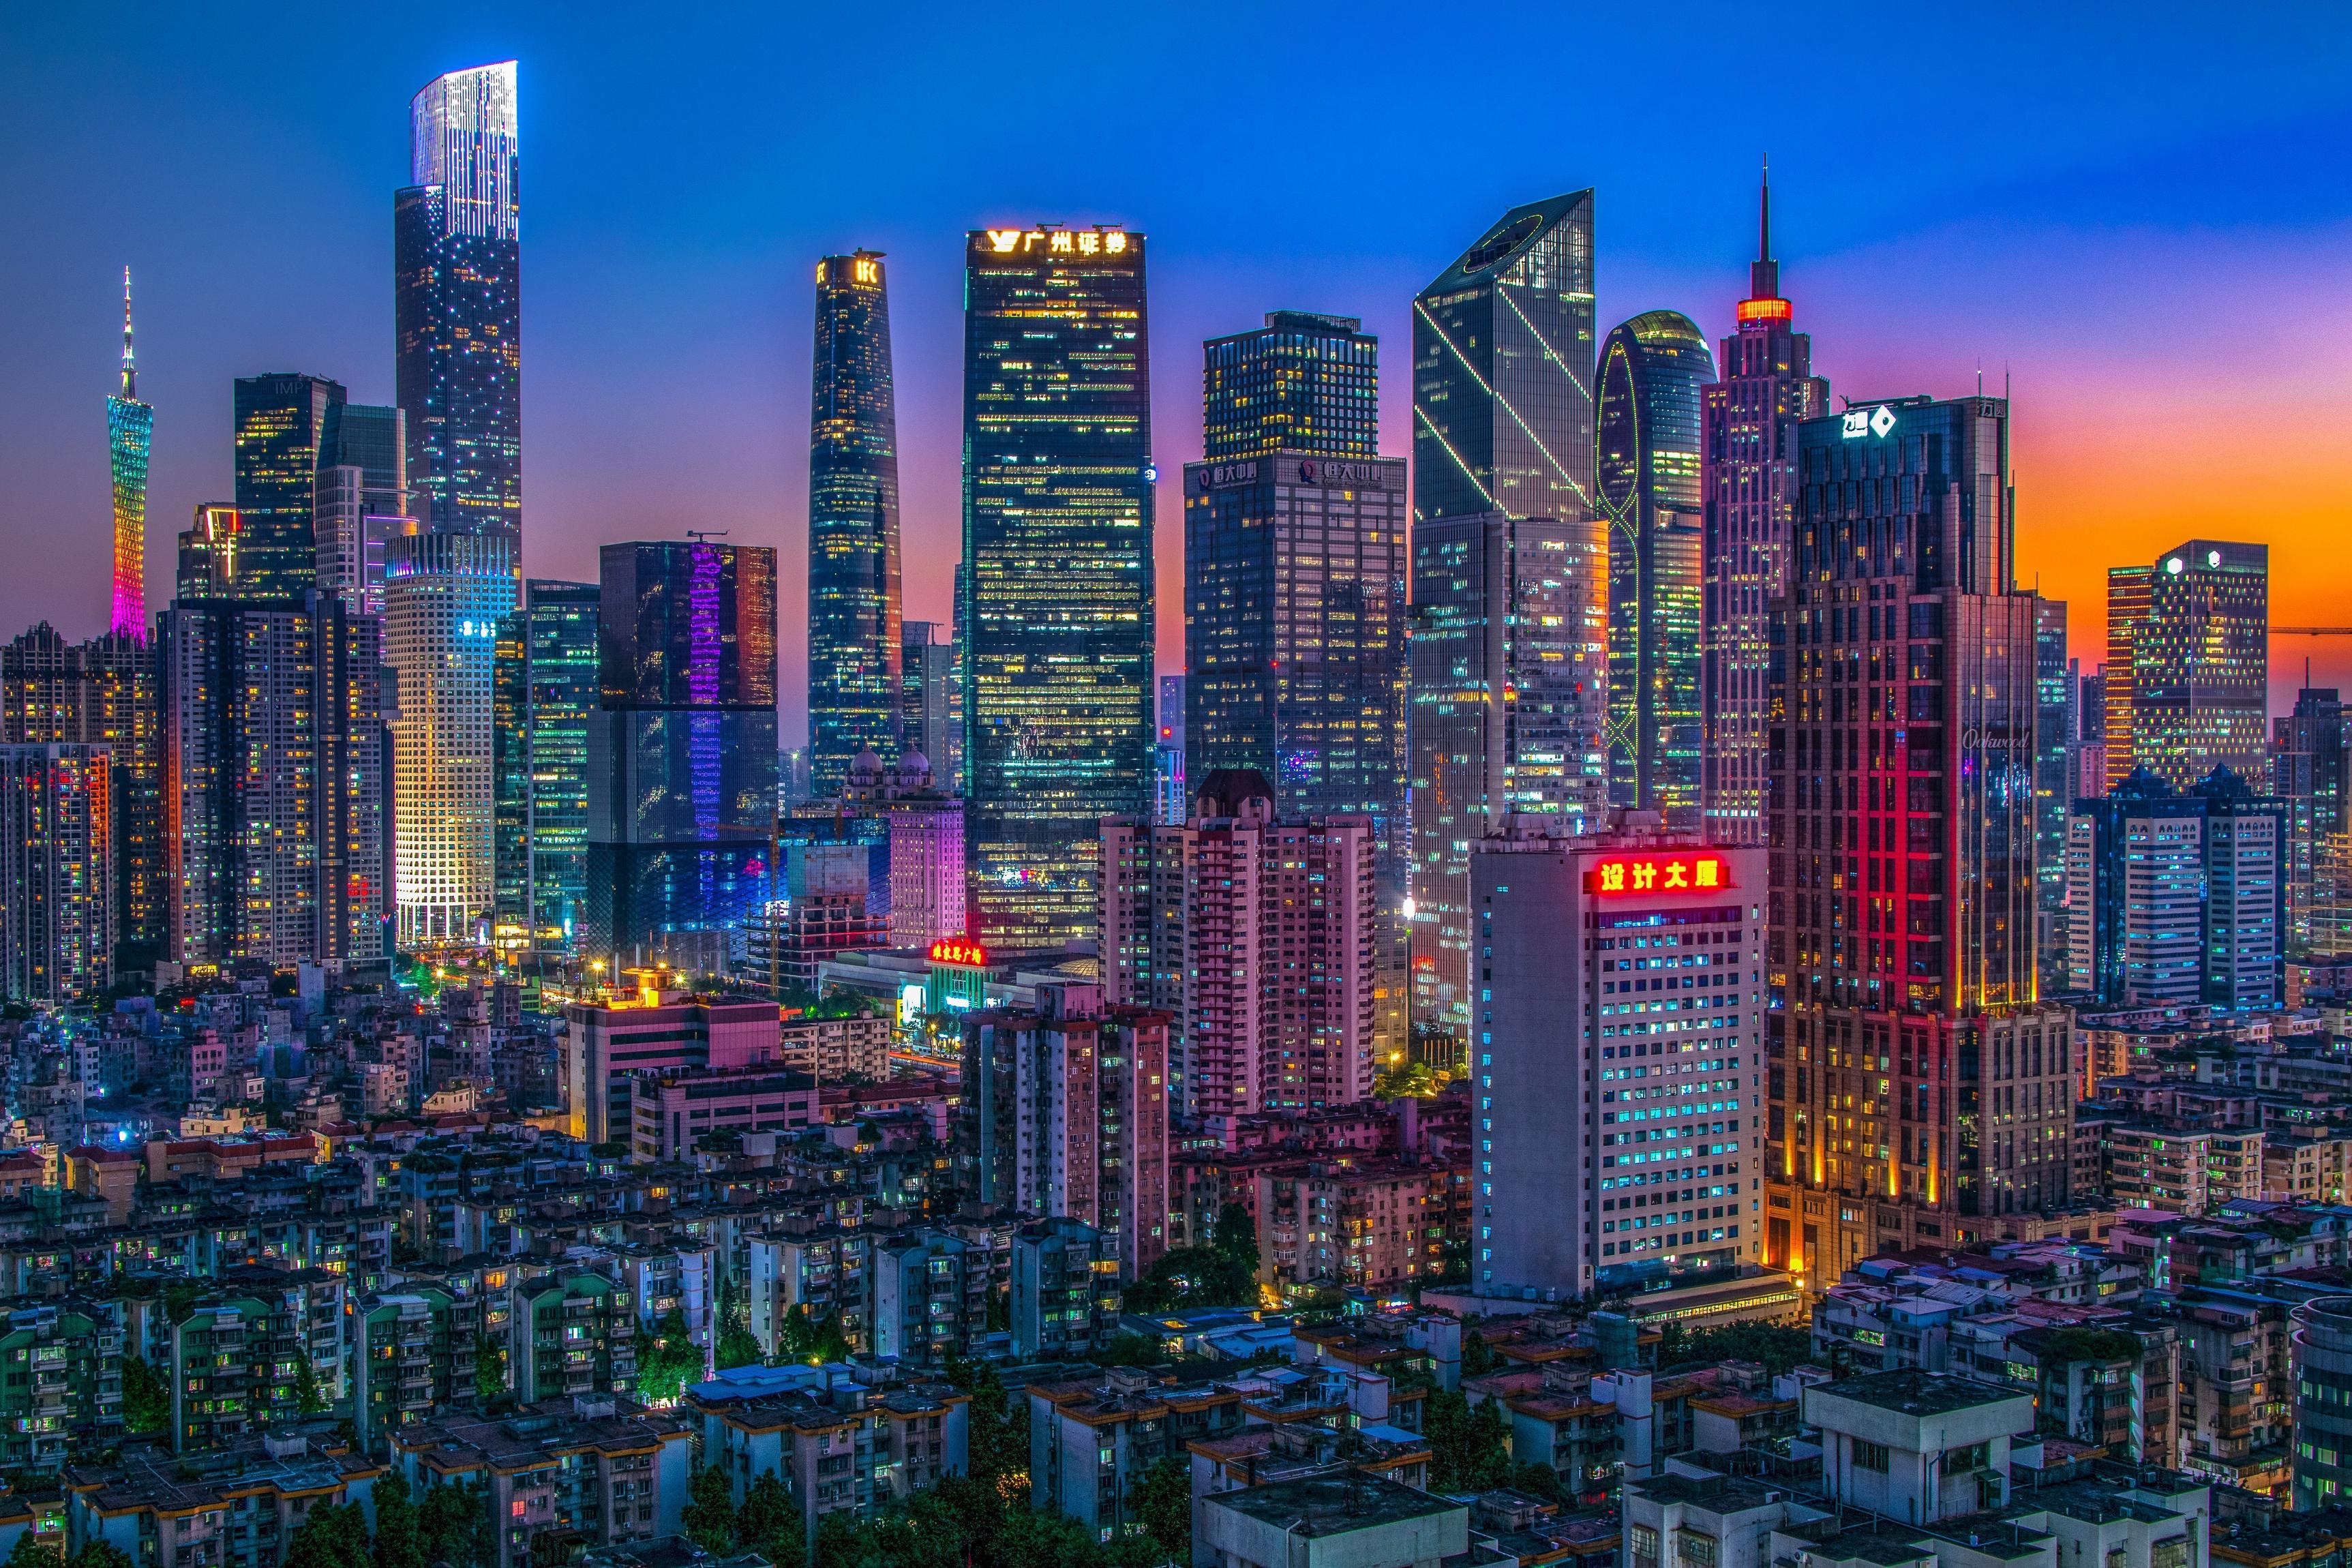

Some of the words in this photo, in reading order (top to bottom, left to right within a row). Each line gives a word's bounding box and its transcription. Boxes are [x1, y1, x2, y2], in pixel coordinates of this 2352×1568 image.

[1023, 231, 1127, 254] 广州证券
[857, 260, 877, 284] IFC
[275, 382, 304, 395] IMP
[1214, 462, 1257, 483] 恒大中心
[1324, 461, 1383, 481] 恒大中心
[1963, 729, 2030, 749] Oakwood
[1601, 860, 1719, 891] 设计大厦
